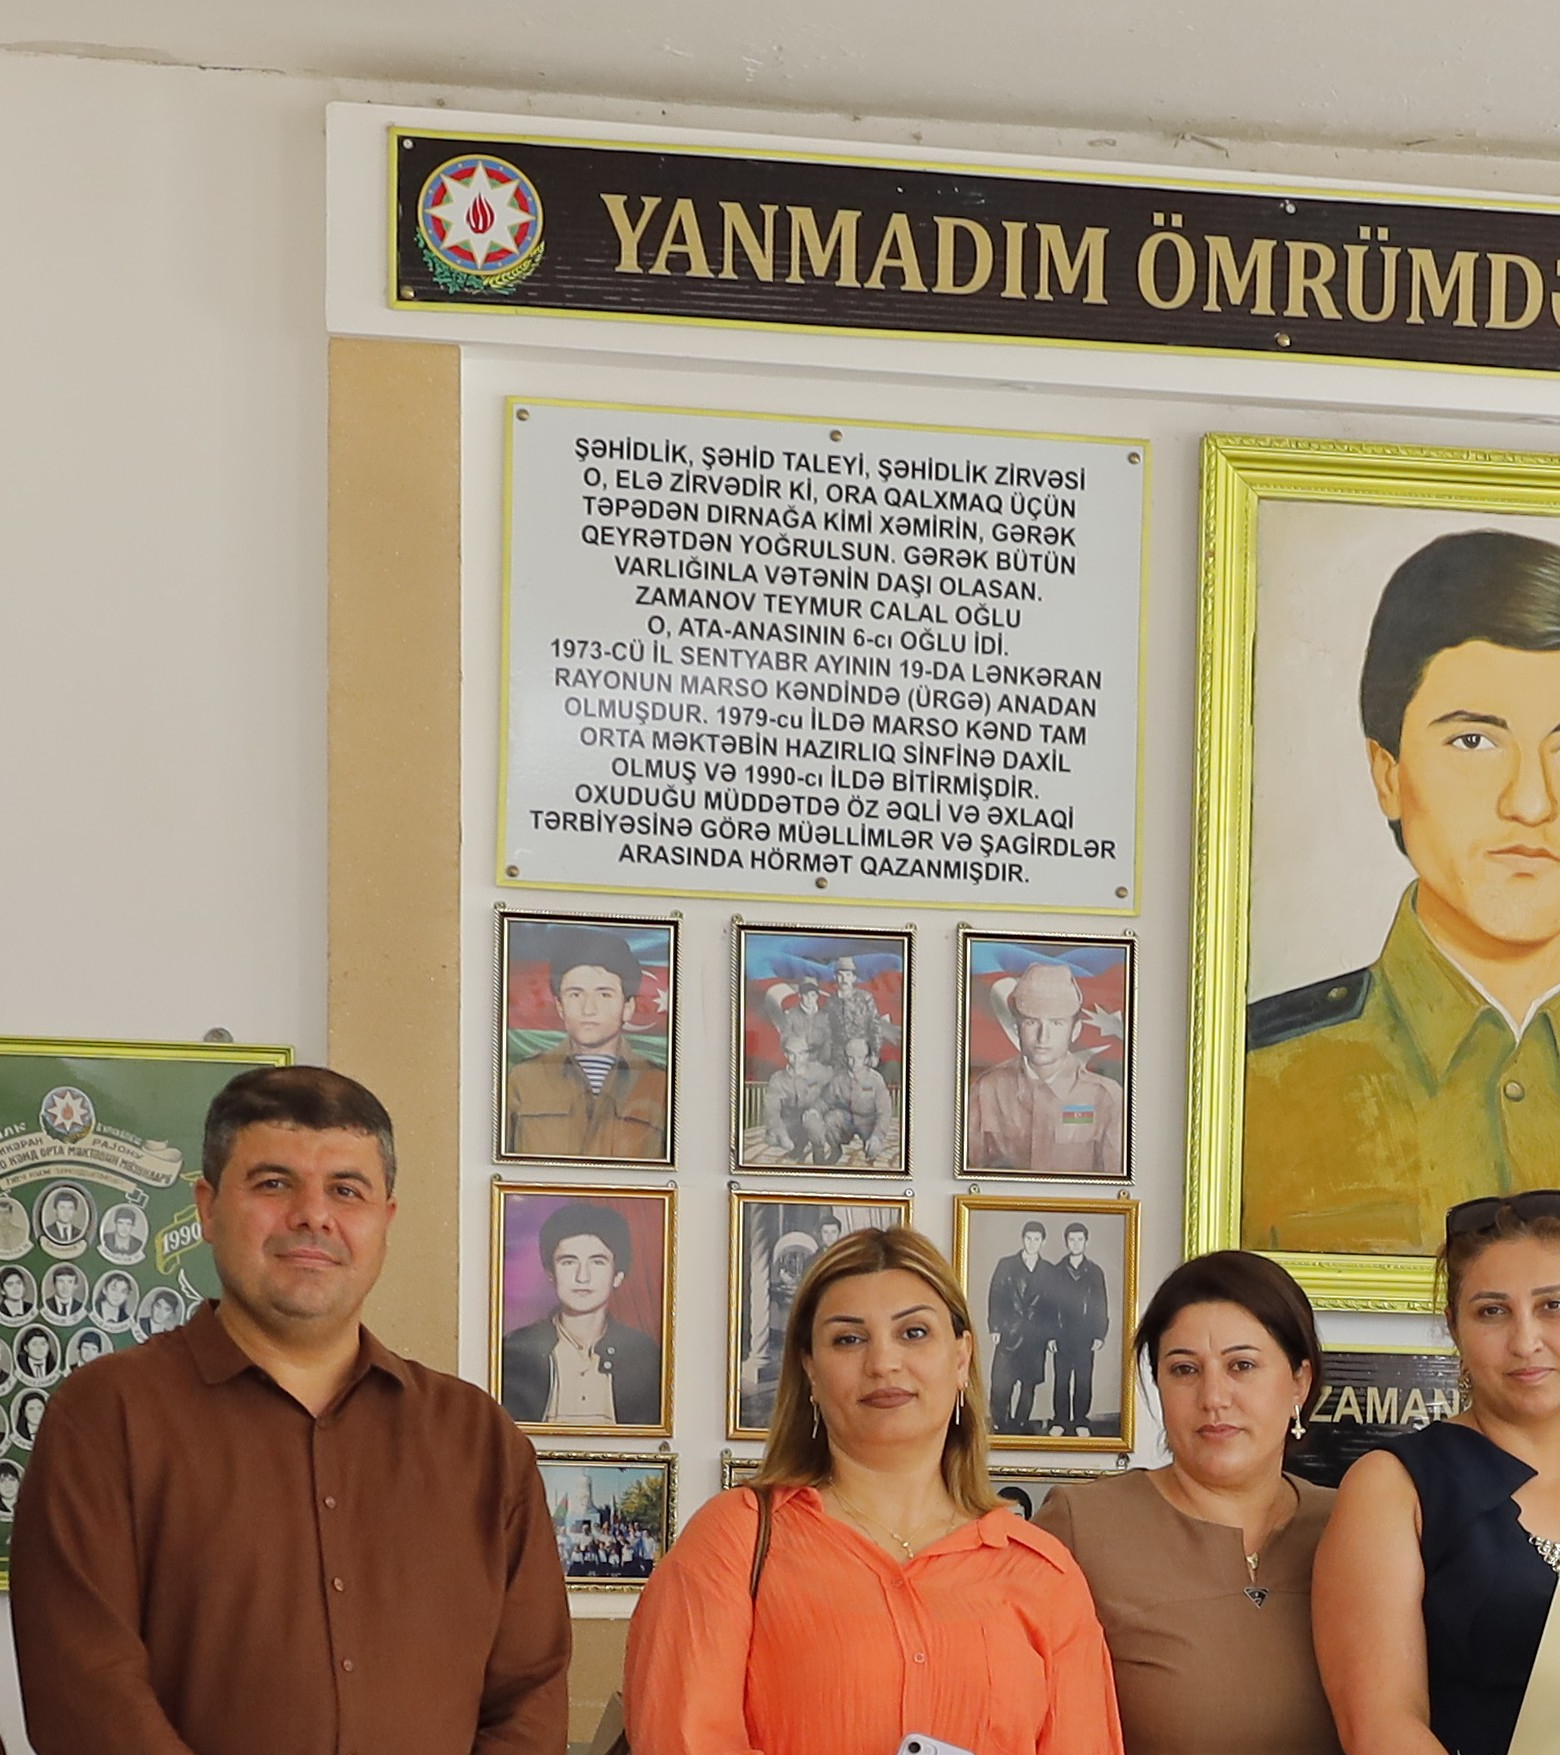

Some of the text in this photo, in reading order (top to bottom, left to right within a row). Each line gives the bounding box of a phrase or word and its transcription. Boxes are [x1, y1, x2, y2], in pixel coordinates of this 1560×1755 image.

[600, 193, 1109, 304] YANMADIM
[573, 435, 1087, 493] ŞƏHİDLİK, ŞƏHİD TALEYİ, ŞƏHİDLİK ZİRVƏSİ
[582, 465, 1077, 523] O, ELƏ ZİRVƏDİR Kİ, ORA QALXMAQ ÜÇÜN
[581, 494, 1078, 549] TƏPƏDƏN DIRNAĞA KİMİ XƏMİRİN, GƏRƏK
[580, 523, 1077, 577] QEYRƏTDƏN YOĞRULSUN. GƏRƏK BÜTÜN
[613, 553, 1043, 603] VARLIĞINLA VƏTƏNİN DAŞI OLASAN.
[634, 584, 1022, 630] ZAMANOV TEYMUR CALAL OĞLU
[646, 613, 1010, 658] O, ATA-ANASININ 6-cı OĞLU İDİ.
[579, 725, 1073, 774] ORTA MƏKTƏBİN HAZIRLIQ SİNFİNƏ DAXİL
[610, 755, 1041, 804] OLMUŞ VƏ 1990-cı İLDƏ BİTİRMİŞDİR.
[573, 782, 1075, 832] OXUDUĞU MÜDDƏTDƏ ÖZ ƏQLİ VƏ ƏXLAQİ
[528, 807, 1118, 861] TƏRBİYƏSİNƏ GÖRƏ MÜƏLLİMLƏR VƏ ŞAGİRDLƏR
[617, 842, 1031, 887] ARASINDA HÖRMƏT QAZANMIŞDIR.
[163, 1221, 201, 1255] 1990
[1309, 1385, 1472, 1426] ZAMAN
